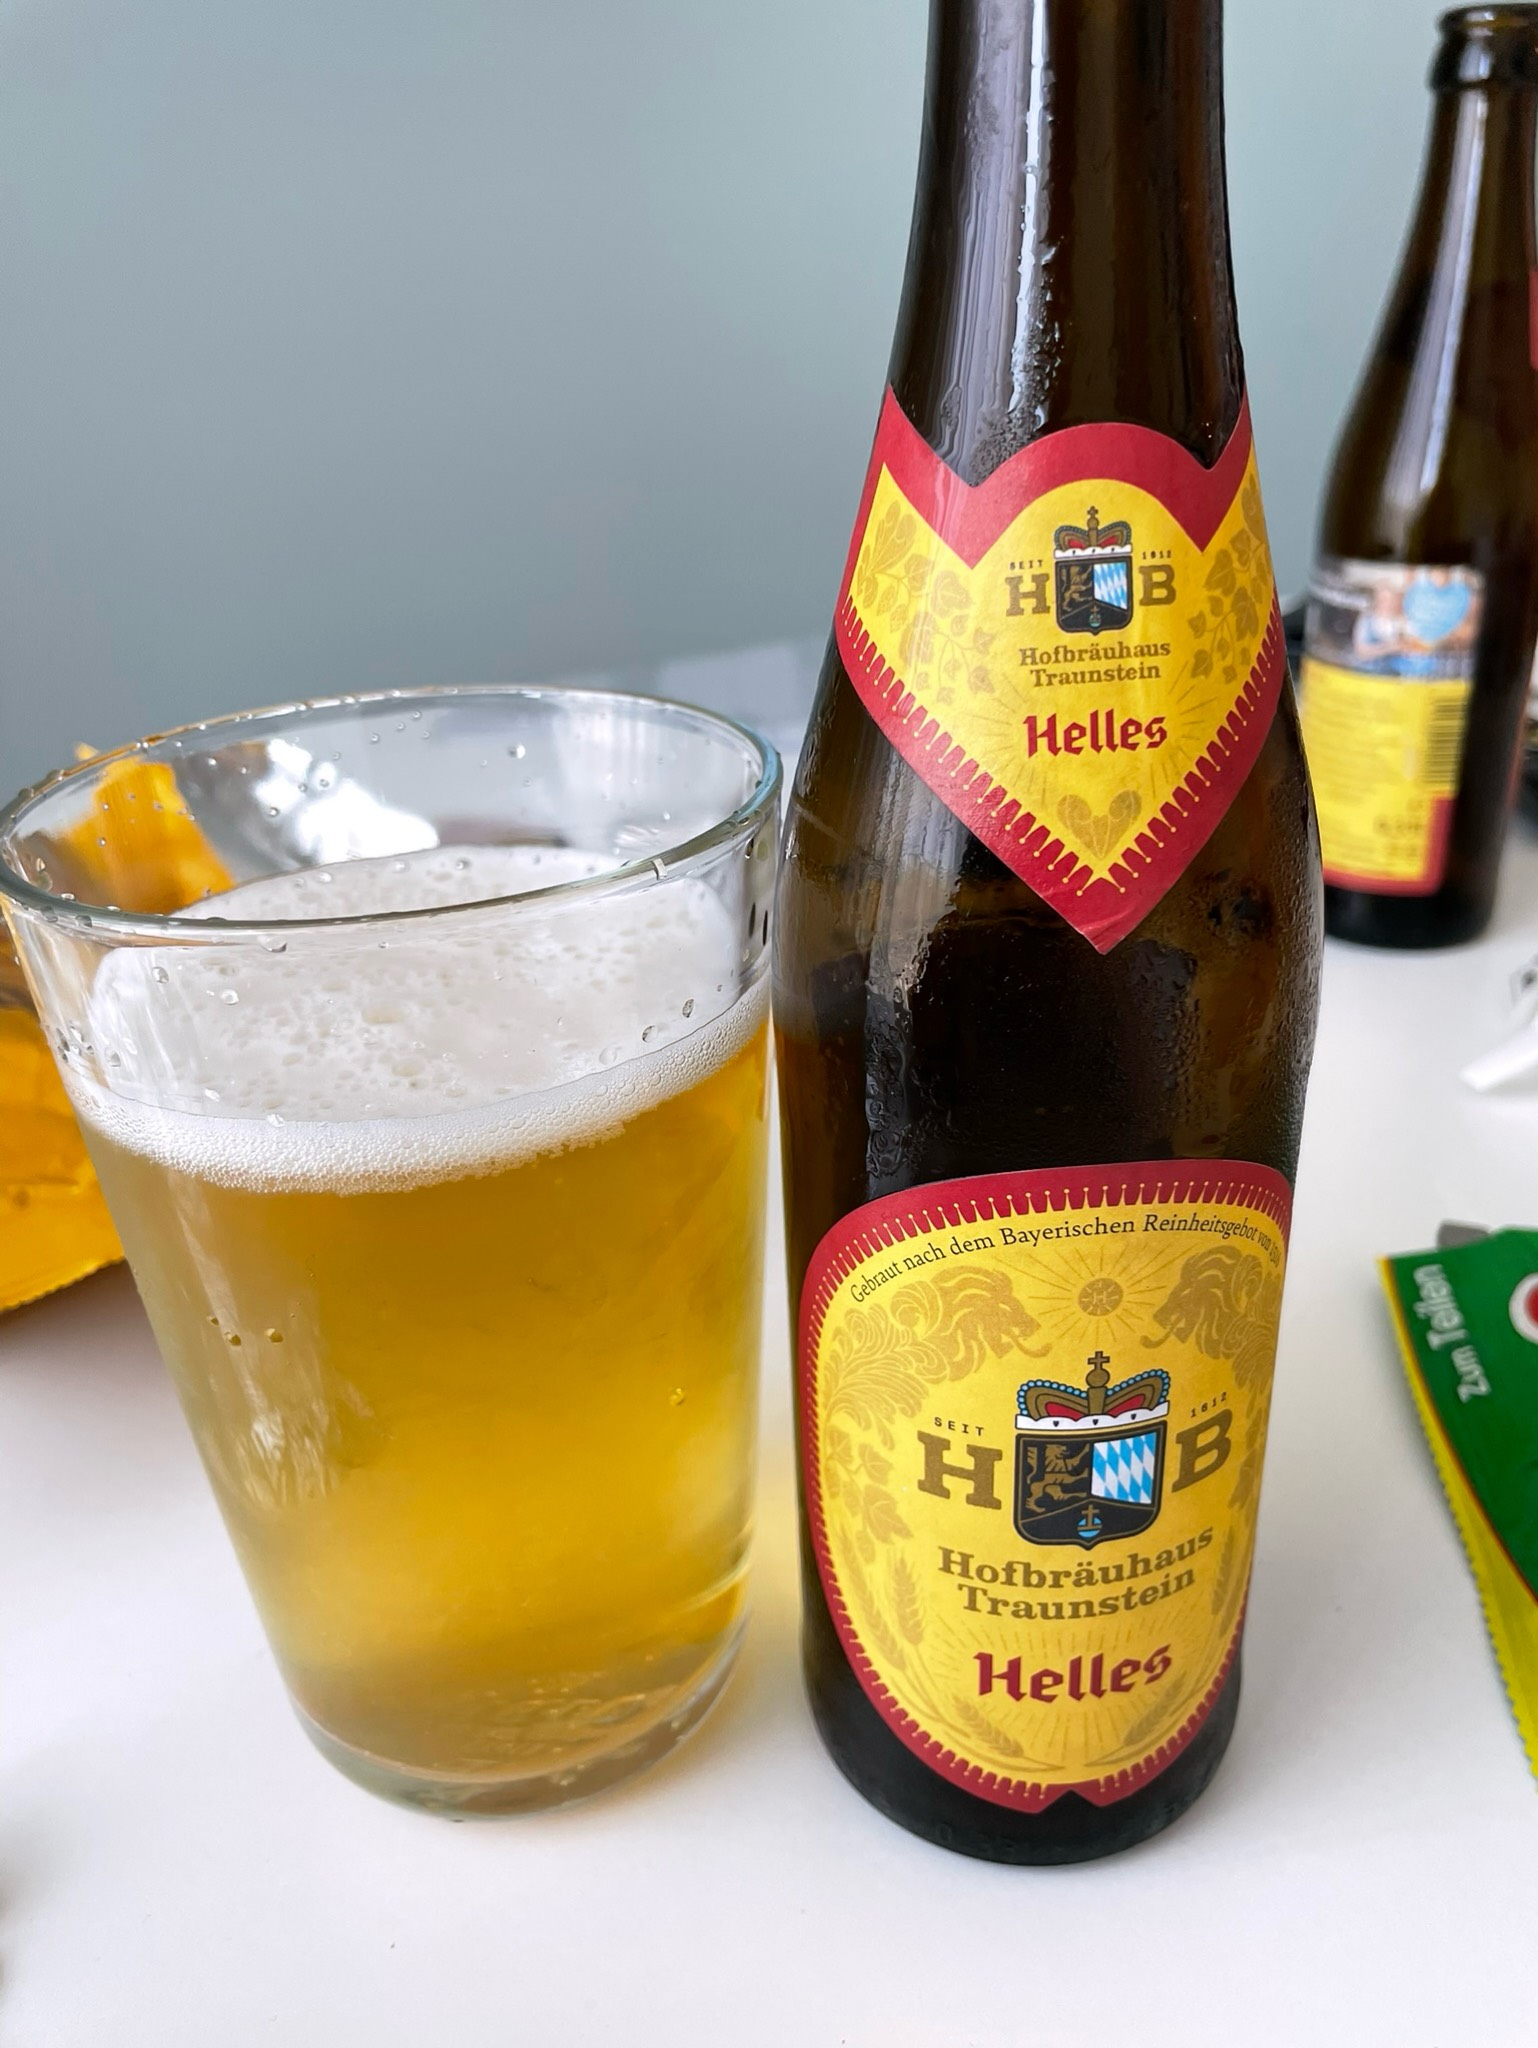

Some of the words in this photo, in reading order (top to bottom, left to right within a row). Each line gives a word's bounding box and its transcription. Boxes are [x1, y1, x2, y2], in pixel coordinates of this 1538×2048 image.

[1004, 573, 1051, 617] H
[1138, 564, 1177, 606] B
[1018, 641, 1171, 667] Hofbräuhaus
[1030, 661, 1161, 688] Traunstein
[1023, 708, 1168, 759] Helles
[850, 1260, 903, 1303] Gebraut
[902, 1242, 947, 1271] nach
[949, 1236, 996, 1255] dem
[999, 1216, 1135, 1247] Bayerischen
[1142, 1213, 1258, 1241] Reinheitsgebot
[1257, 1231, 1272, 1251] von
[1412, 1263, 1470, 1351] Teilen
[1451, 1345, 1492, 1404] Zum
[934, 1416, 984, 1436] SEIT
[1190, 1391, 1227, 1418] 1612
[917, 1430, 1003, 1510] H
[1171, 1408, 1233, 1493] B
[938, 1525, 1214, 1588] Hofbräuhaus
[957, 1568, 1196, 1620] Traunstein
[973, 1644, 1172, 1703] Helles
